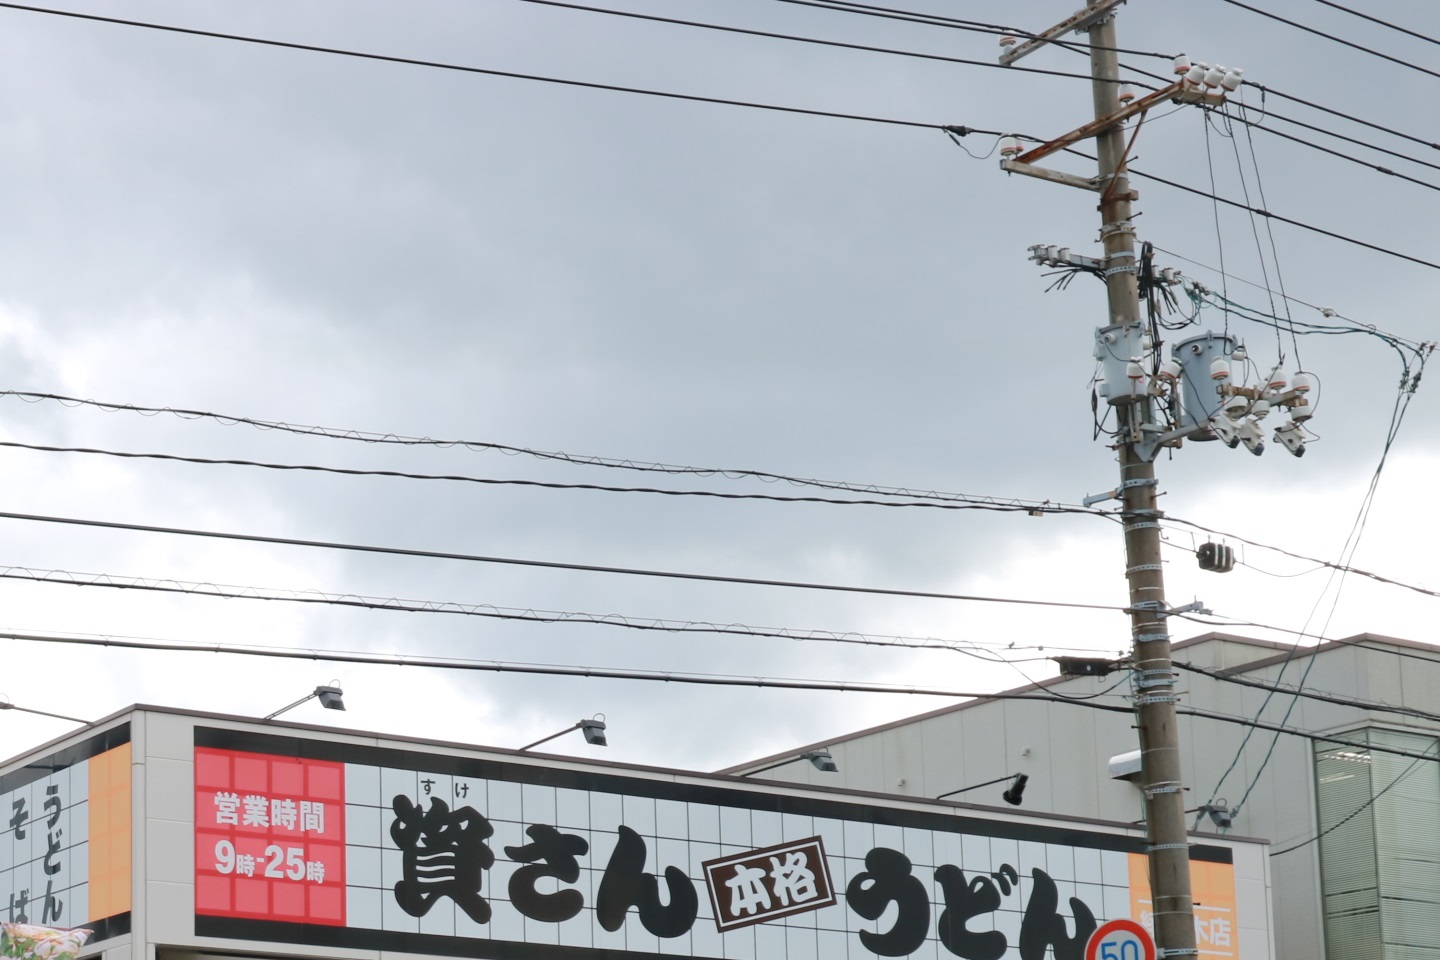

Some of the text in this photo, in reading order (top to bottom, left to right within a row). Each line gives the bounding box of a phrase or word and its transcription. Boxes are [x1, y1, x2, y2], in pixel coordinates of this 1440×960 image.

[214, 791, 326, 834] 営業時間
[420, 779, 470, 799] すけ
[43, 785, 64, 923] うどん
[390, 793, 699, 939] 資さん
[724, 850, 822, 917] 本格
